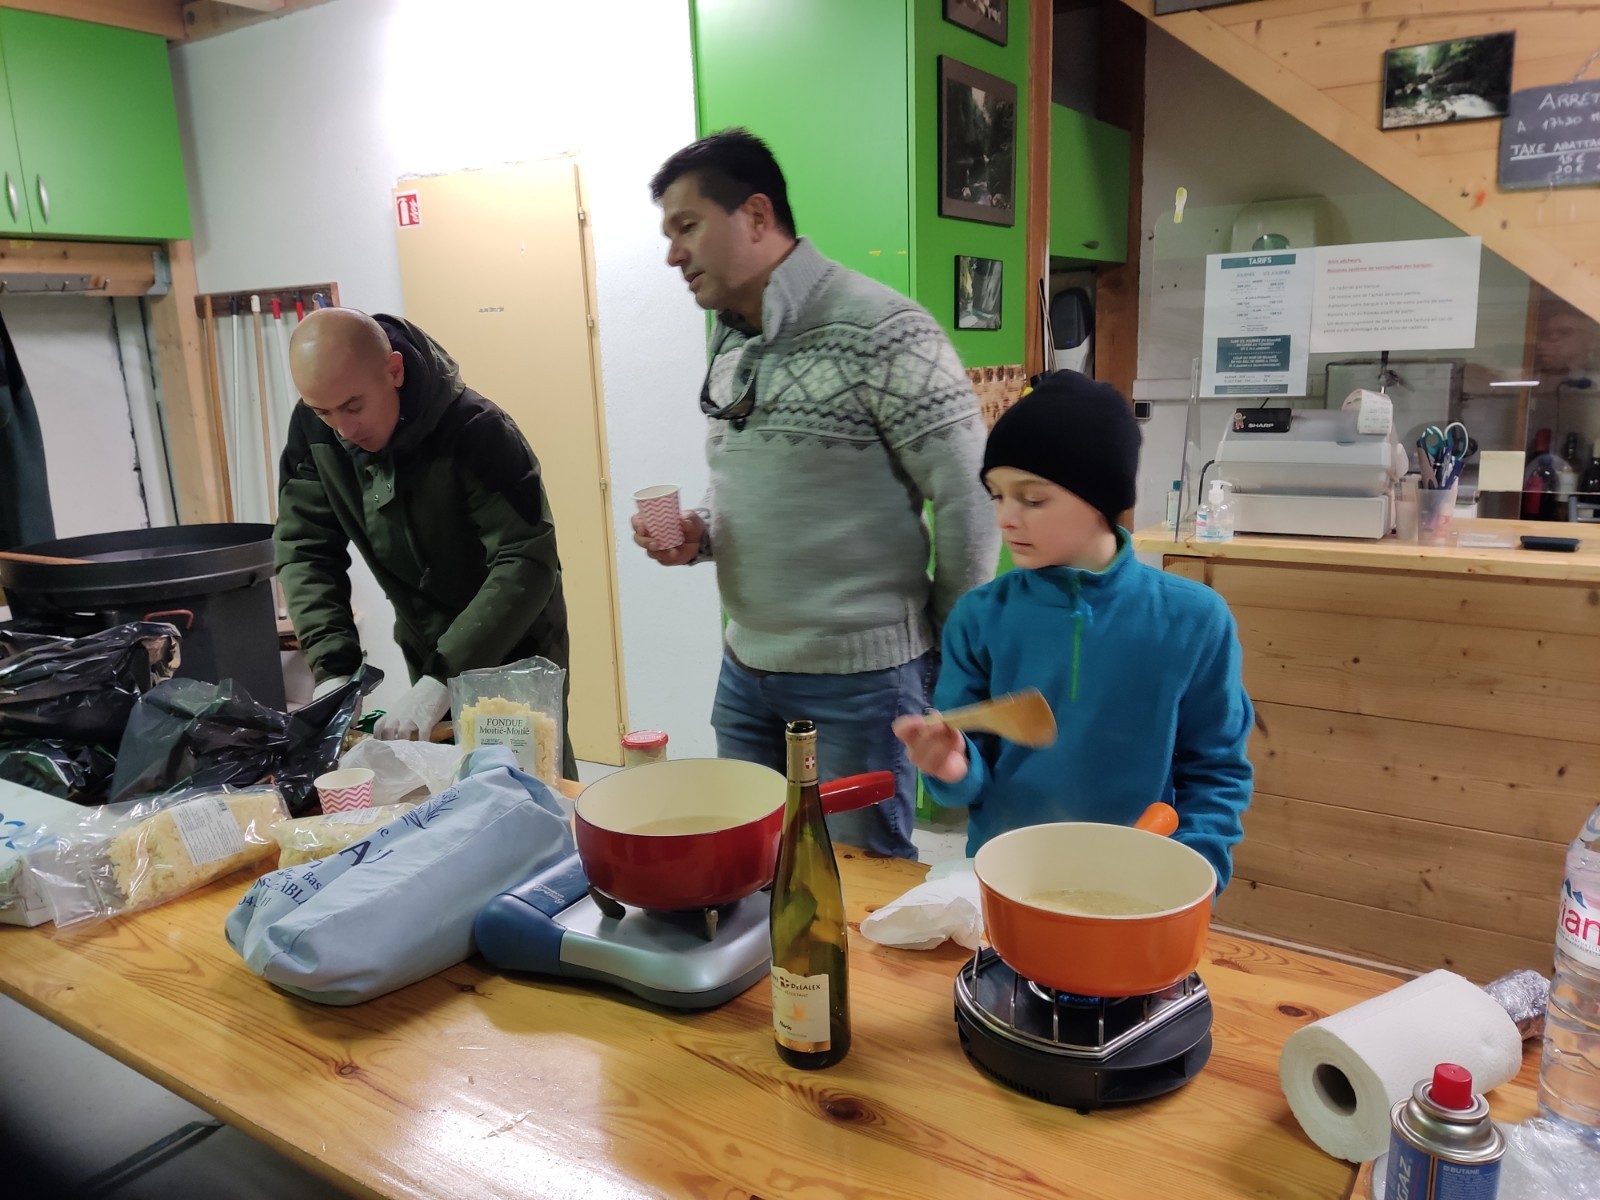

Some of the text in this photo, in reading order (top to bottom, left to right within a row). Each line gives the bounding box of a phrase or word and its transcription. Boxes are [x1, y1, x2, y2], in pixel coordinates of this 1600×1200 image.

[1510, 143, 1546, 157] TAXE
[1248, 256, 1272, 265] TARIFS
[486, 718, 523, 727] FONDUE
[479, 725, 530, 735] Moitié-Moitié
[1450, 1165, 1480, 1175] BUTANE
